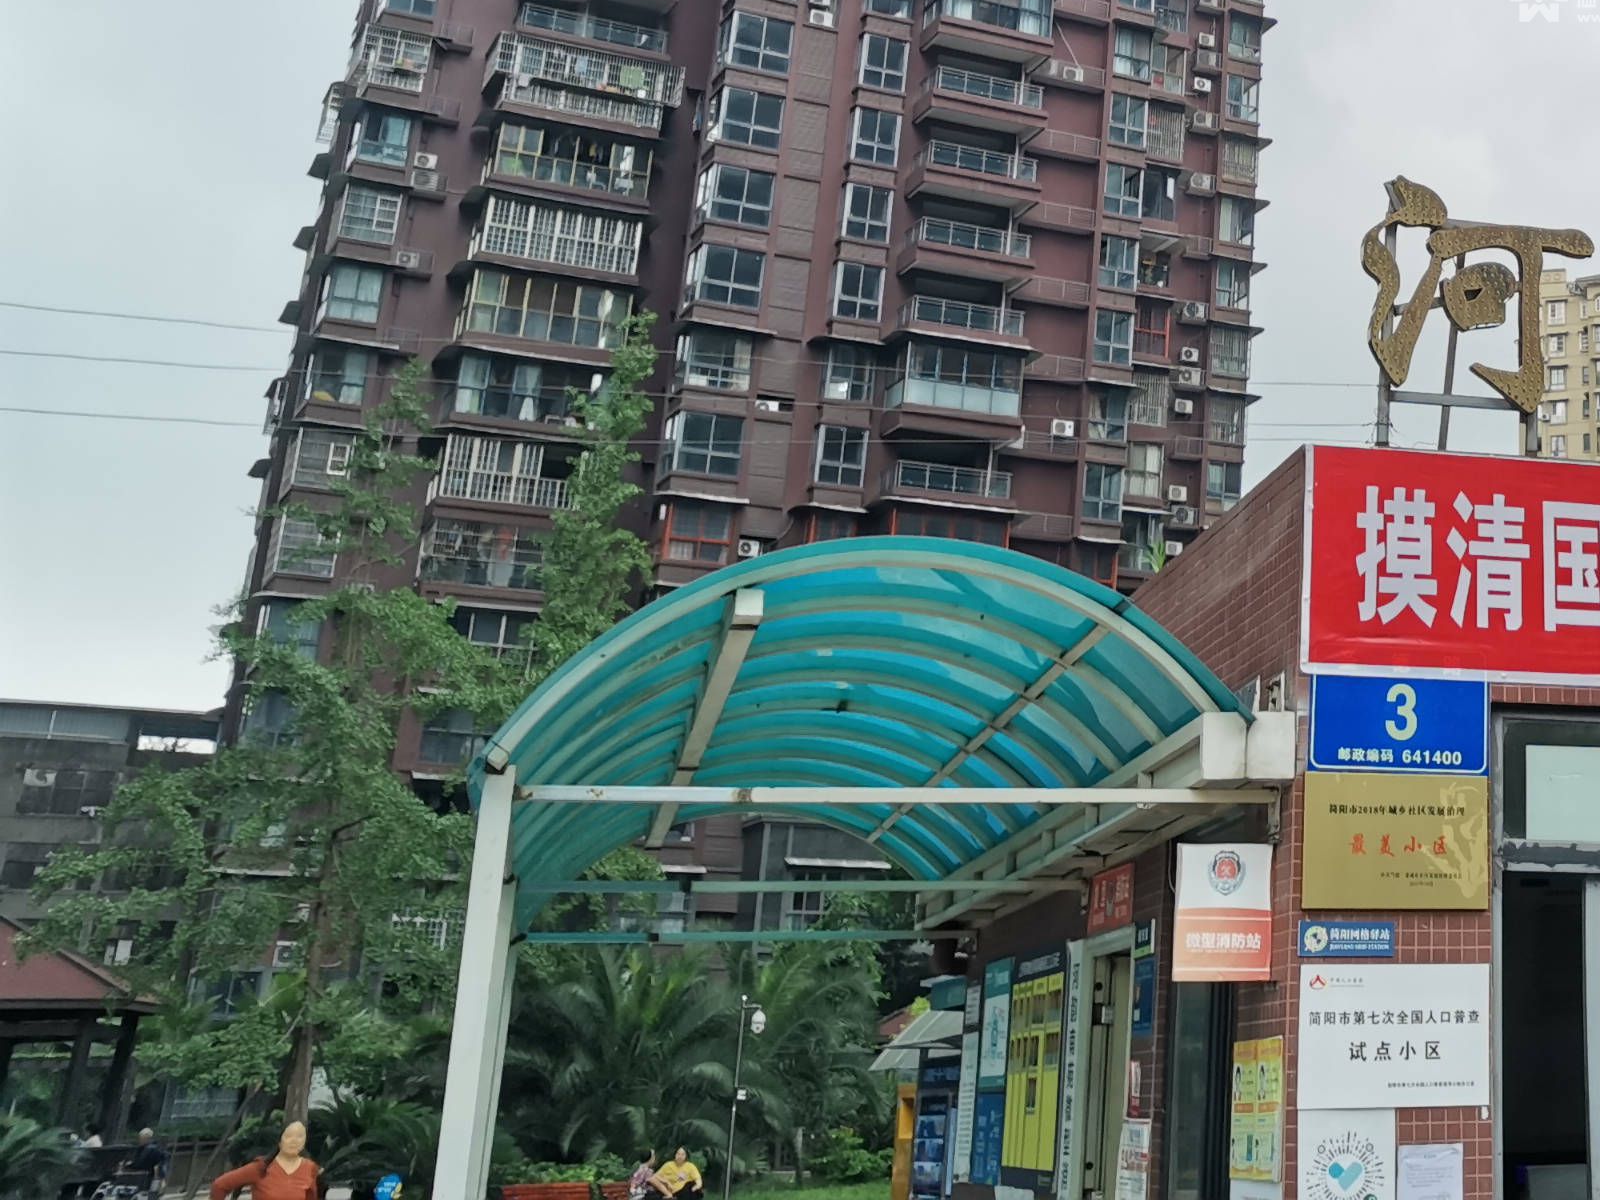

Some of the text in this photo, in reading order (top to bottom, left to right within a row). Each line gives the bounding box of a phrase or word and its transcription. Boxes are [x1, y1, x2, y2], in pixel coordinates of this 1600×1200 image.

[1385, 683, 1418, 741] 3
[1337, 746, 1463, 766] 邮政编码 641400
[1349, 832, 1449, 858] 最美小区
[1185, 932, 1262, 950] 微型消防站
[1309, 1009, 1481, 1027] 简阳市第七次全国人口普查
[1349, 1041, 1441, 1062] 试点小区
